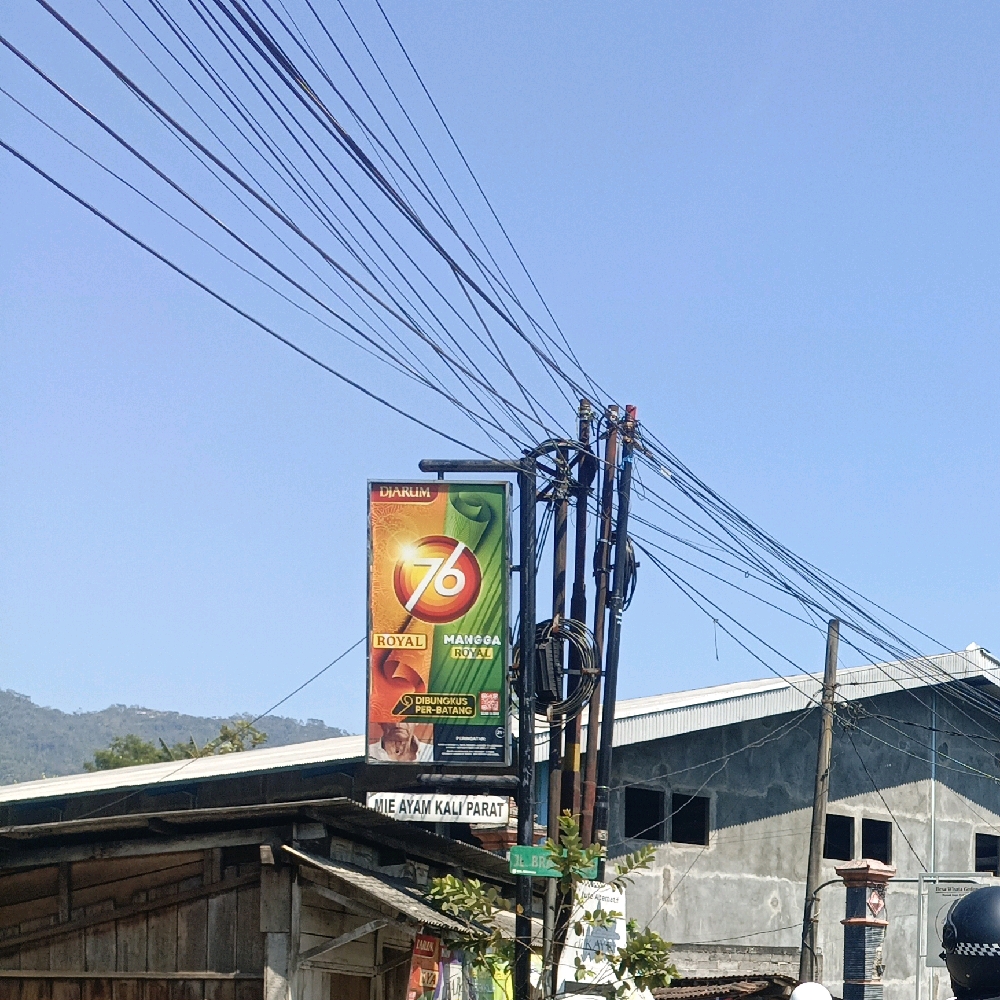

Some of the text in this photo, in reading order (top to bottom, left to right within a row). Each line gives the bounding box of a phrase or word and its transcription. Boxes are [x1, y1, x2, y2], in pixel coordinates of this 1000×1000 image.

[379, 486, 431, 499] DJARUM
[404, 541, 467, 613] 76
[376, 635, 424, 648] ROYAL
[443, 634, 502, 646] MANGGA
[454, 648, 492, 658] ROYAL
[415, 696, 468, 706] DIBUNGKUS
[415, 705, 473, 715] PER-BATANG
[374, 798, 504, 818] MIE AYAM KALI PARAT
